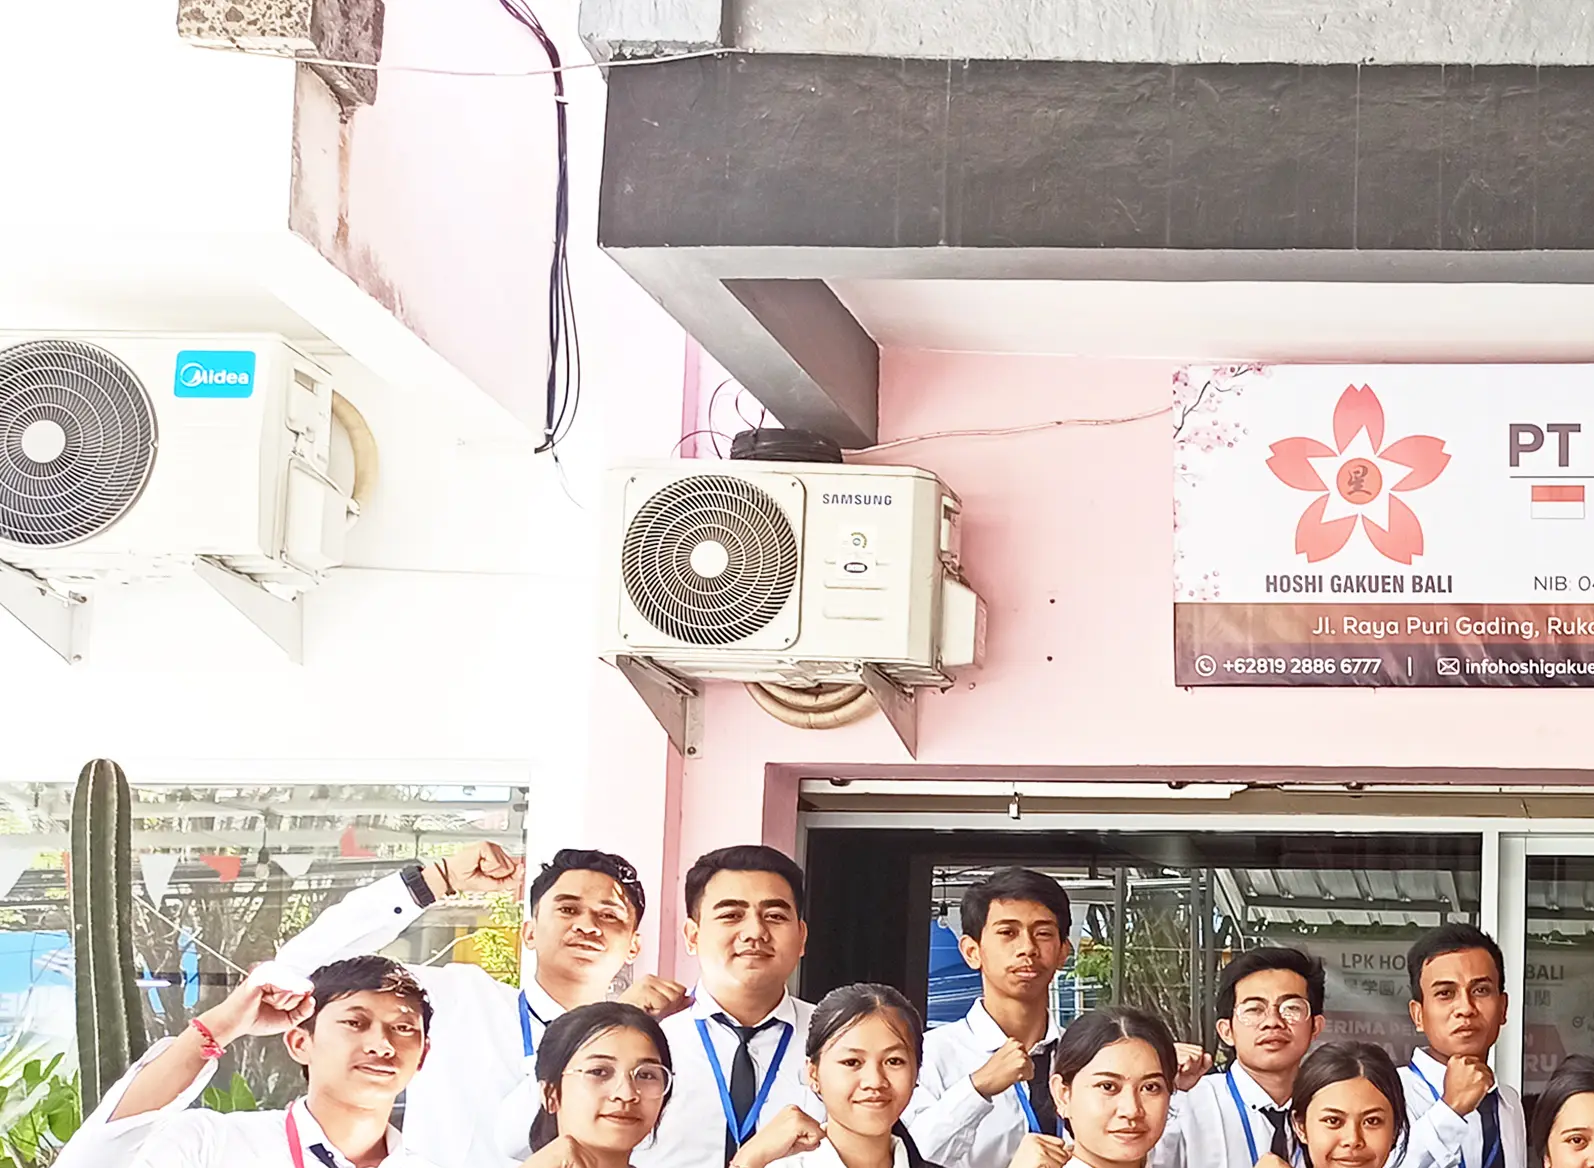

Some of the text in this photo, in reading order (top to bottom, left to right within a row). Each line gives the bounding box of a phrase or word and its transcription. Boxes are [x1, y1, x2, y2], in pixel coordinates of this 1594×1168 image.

[182, 362, 249, 387] Midea
[1508, 423, 1581, 468] PT
[822, 493, 893, 507] SAMSUNG
[1265, 574, 1453, 594] HOSHI GAKUEN BALI
[1533, 575, 1573, 592] NIB:
[1312, 616, 1337, 636] Jl.
[1343, 616, 1400, 640] Raya
[1406, 616, 1449, 636] Puri
[1455, 616, 1541, 640] Gading,
[1222, 657, 1382, 675] +62819 2886 6777
[1341, 952, 1406, 971] LPK HO
[1525, 964, 1564, 981] BALI
[1324, 1019, 1386, 1036] ERIMA
[1526, 1053, 1559, 1073] RU
